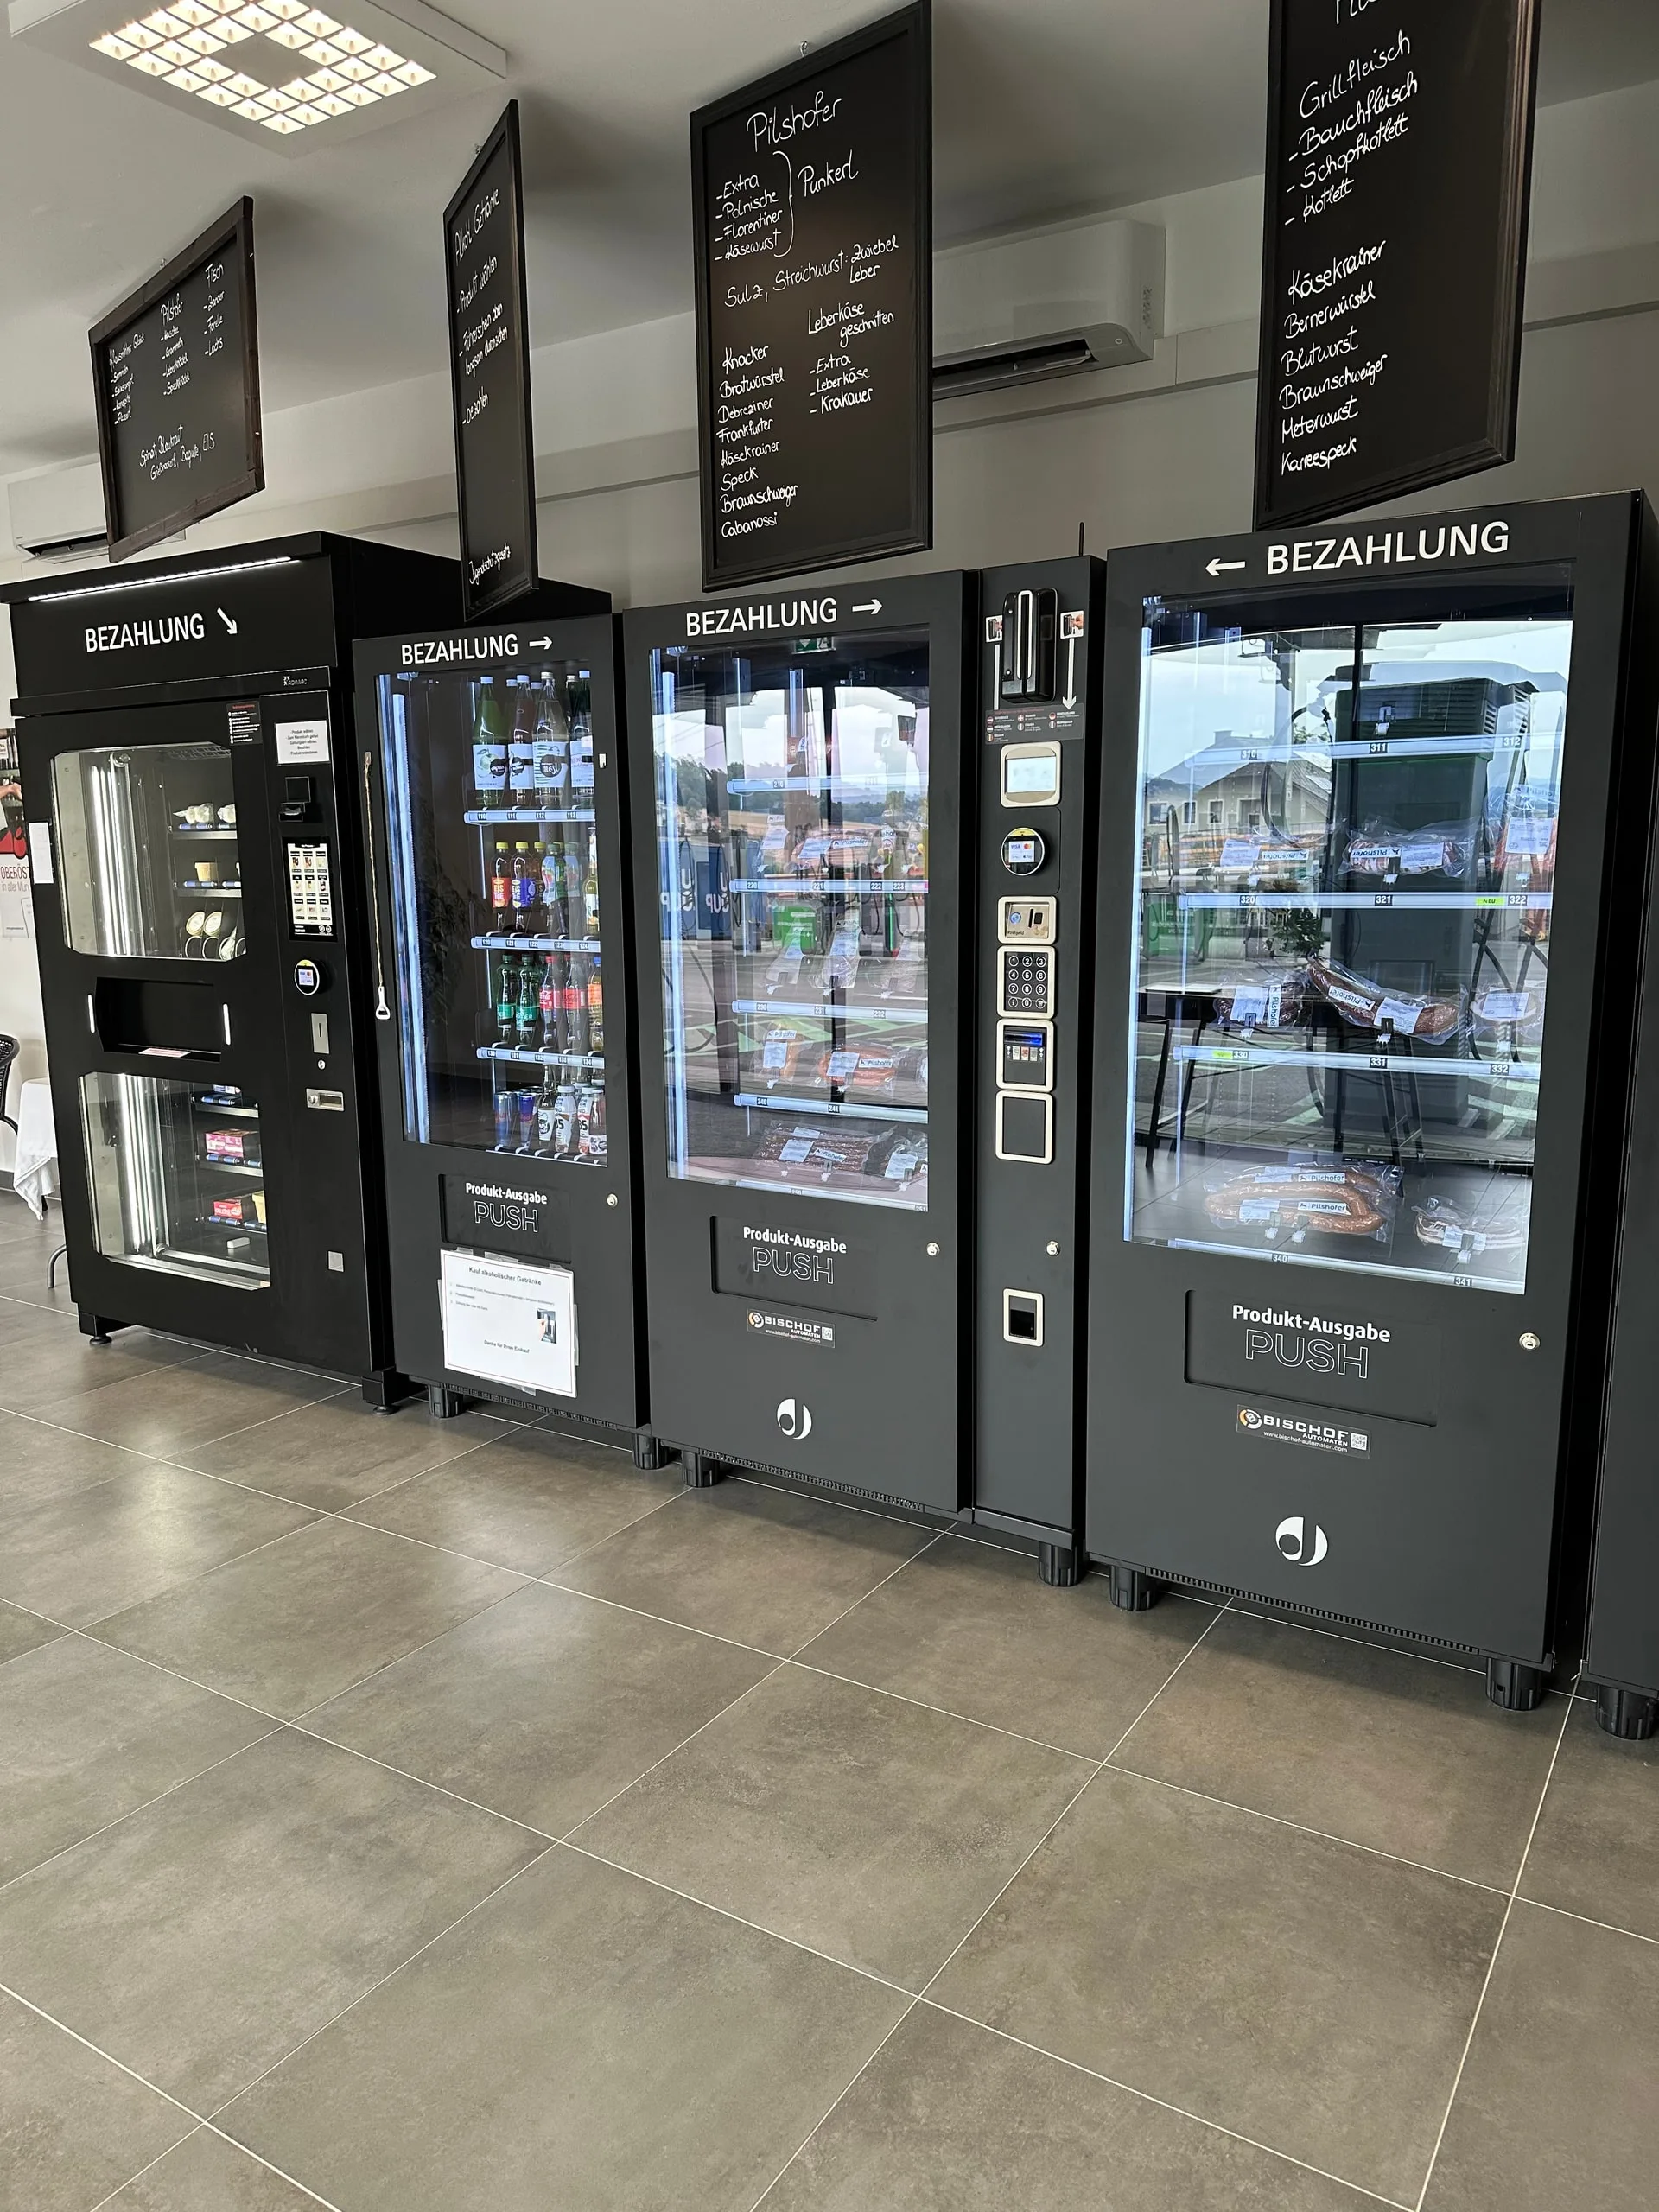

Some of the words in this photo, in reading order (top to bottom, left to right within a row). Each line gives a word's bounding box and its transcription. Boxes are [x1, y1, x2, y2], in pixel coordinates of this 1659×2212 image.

[1299, 29, 1410, 118] Grillfleisch
[747, 90, 842, 152] Pilshofer
[797, 149, 859, 197] Punkerl
[205, 259, 224, 289] Fisch
[849, 264, 880, 284] Leber
[1287, 240, 1387, 305] Käsekrainer
[808, 302, 865, 334] Leberkäse
[1284, 280, 1376, 339] Bernerwürstel
[840, 309, 894, 348] geschnitten
[721, 345, 769, 374] Knacker
[1281, 325, 1359, 377] Blutwurst
[720, 366, 785, 399] Bratwürstel
[1279, 353, 1388, 410] Braunschweiger
[717, 397, 774, 423] Debreziner
[1281, 394, 1358, 444] Meterwurst
[716, 417, 774, 444] Frankfurter
[720, 441, 780, 468] Käsekrainer
[1281, 435, 1357, 476] Karreespeck
[720, 467, 759, 492] Speck
[720, 484, 798, 515] Braunschweiger
[721, 511, 779, 538] Cabanossi
[1267, 520, 1509, 575] BEZAHLUNG
[686, 597, 837, 637] BEZAHLUNG
[85, 613, 205, 652] BEZAHLUNG
[401, 633, 518, 665] BEZAHLUNG
[1241, 749, 1258, 760] 310
[1370, 742, 1388, 753] 311
[1503, 735, 1521, 747] 312
[747, 881, 758, 890] 220
[812, 881, 824, 890] 221
[870, 881, 882, 890] 222
[893, 881, 905, 890] 223
[1240, 895, 1255, 905] 320
[1376, 895, 1391, 905] 321
[1509, 895, 1527, 905] 322
[815, 1006, 826, 1014] 231
[1233, 1051, 1248, 1059] 330
[1491, 1065, 1508, 1073] 332
[757, 1096, 767, 1105] 240
[828, 1104, 839, 1113] 241
[1310, 1173, 1345, 1183] Pilshofer
[466, 1182, 547, 1205] Produkt-Ausgabe
[1311, 1202, 1347, 1212] Pilshofer
[474, 1200, 538, 1233] PUSH
[743, 1226, 847, 1254] Produkt-Ausgabe
[468, 1266, 481, 1274] Kauf
[481, 1268, 516, 1281] alkoholischer
[517, 1276, 542, 1286] Getränke
[753, 1246, 834, 1284] PUSH
[1273, 1254, 1287, 1263] 340
[1455, 1277, 1471, 1286] 341
[764, 1315, 821, 1333] BISCHOF
[790, 1328, 821, 1338] AUTOMATEN
[1232, 1304, 1391, 1343] Produkt-Ausgabe
[484, 1339, 496, 1348] Danke
[1245, 1328, 1369, 1379] PUSH
[1263, 1414, 1349, 1440] BISCHOF
[1302, 1433, 1348, 1446] AUTOMATEN
[1263, 1431, 1348, 1452] www.bischof-automaten.com
